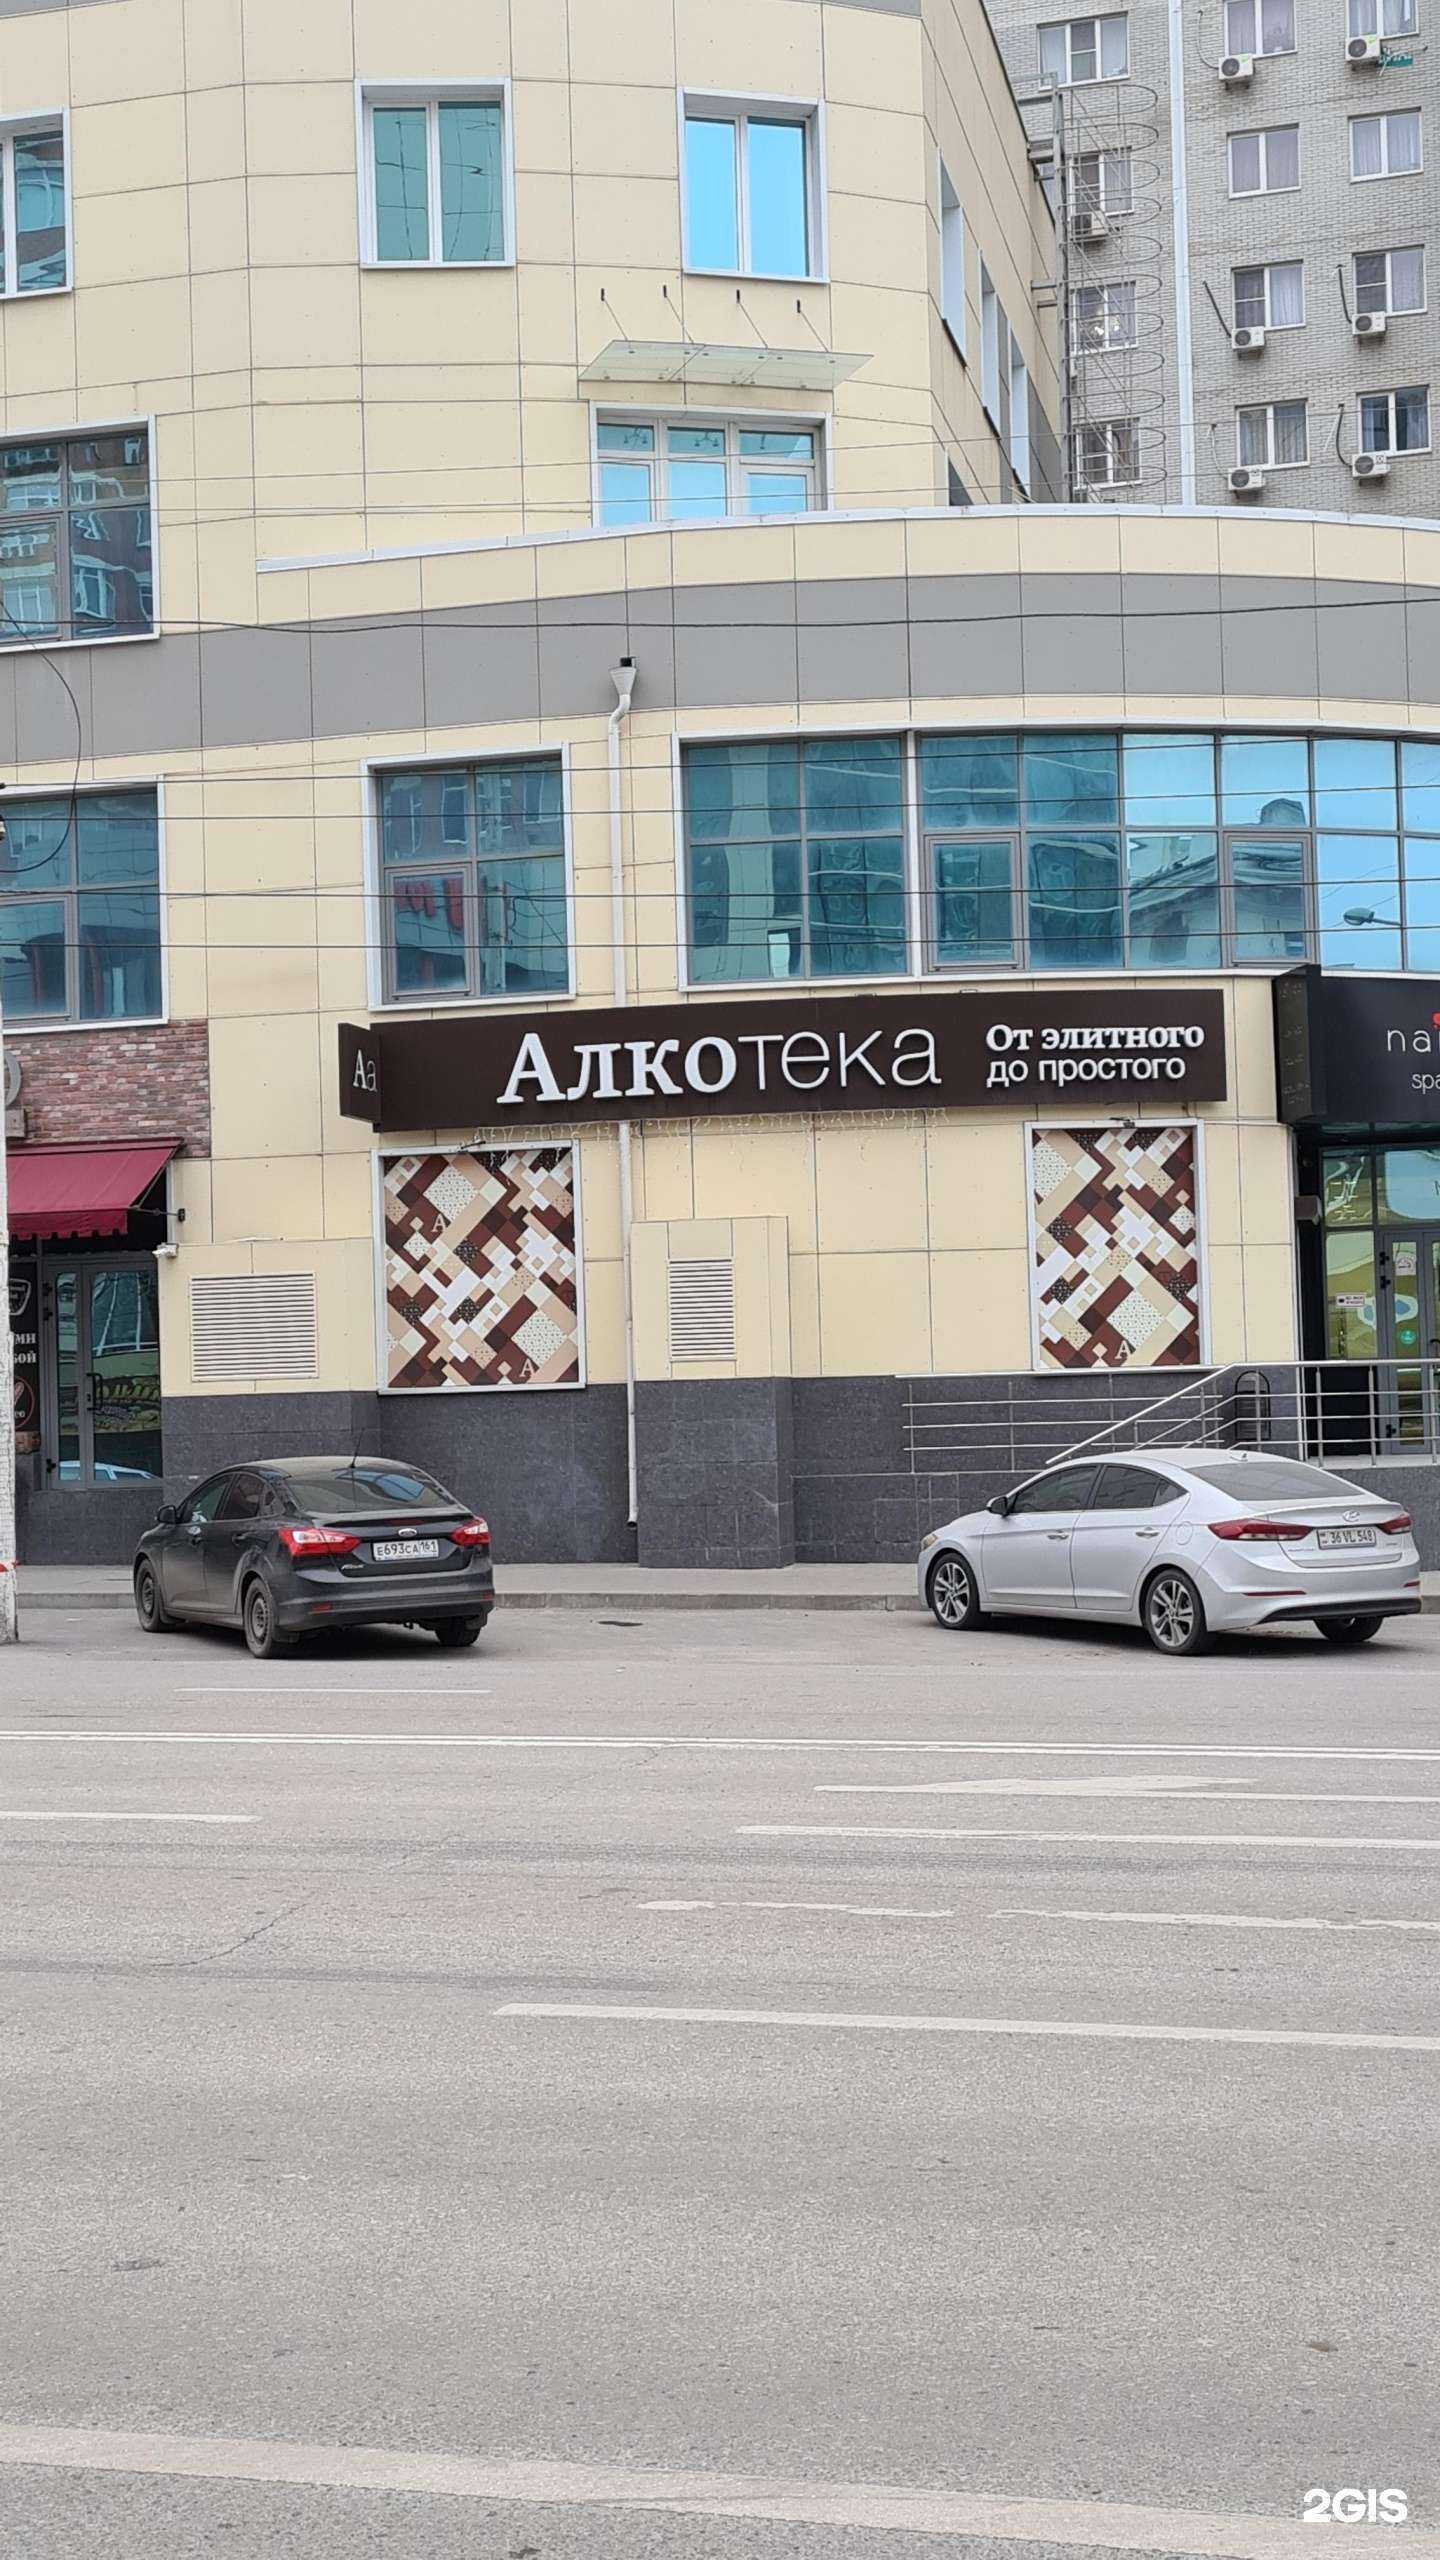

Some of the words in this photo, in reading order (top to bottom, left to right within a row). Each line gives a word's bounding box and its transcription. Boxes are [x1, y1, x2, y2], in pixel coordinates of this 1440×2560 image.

[986, 1024, 1033, 1051] От
[1041, 1026, 1205, 1051] элитного
[496, 1028, 942, 1104] Алкотека
[986, 1060, 1028, 1088] до
[1039, 1056, 1186, 1088] простого
